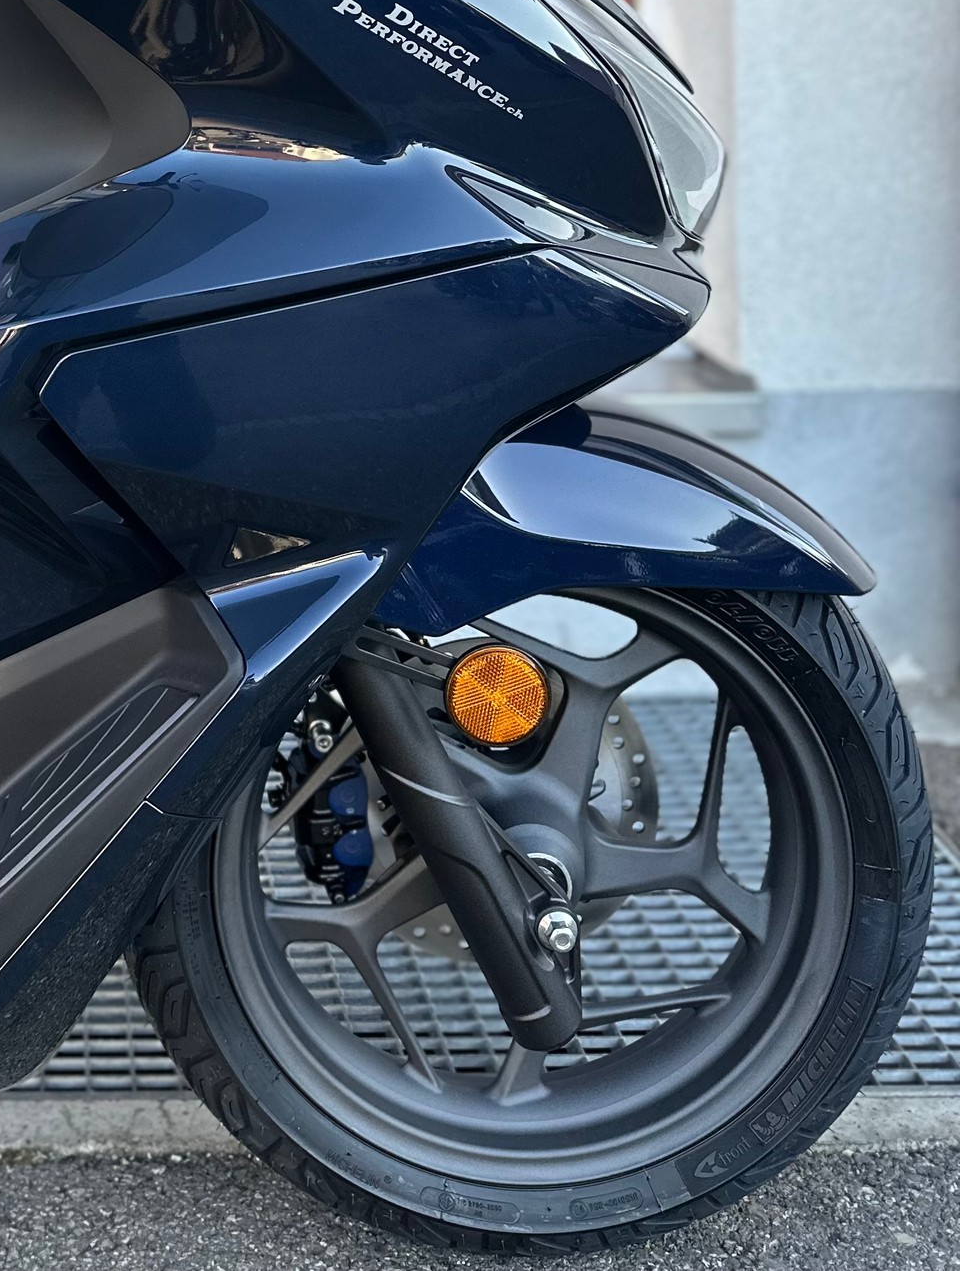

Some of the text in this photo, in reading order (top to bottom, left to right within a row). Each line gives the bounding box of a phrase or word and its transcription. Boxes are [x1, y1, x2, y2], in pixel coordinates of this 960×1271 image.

[384, 3, 480, 66] DIRECT
[780, 978, 866, 1115] MICHELIN
[324, 1148, 380, 1190] MICHELIN
[718, 1138, 751, 1166] front
